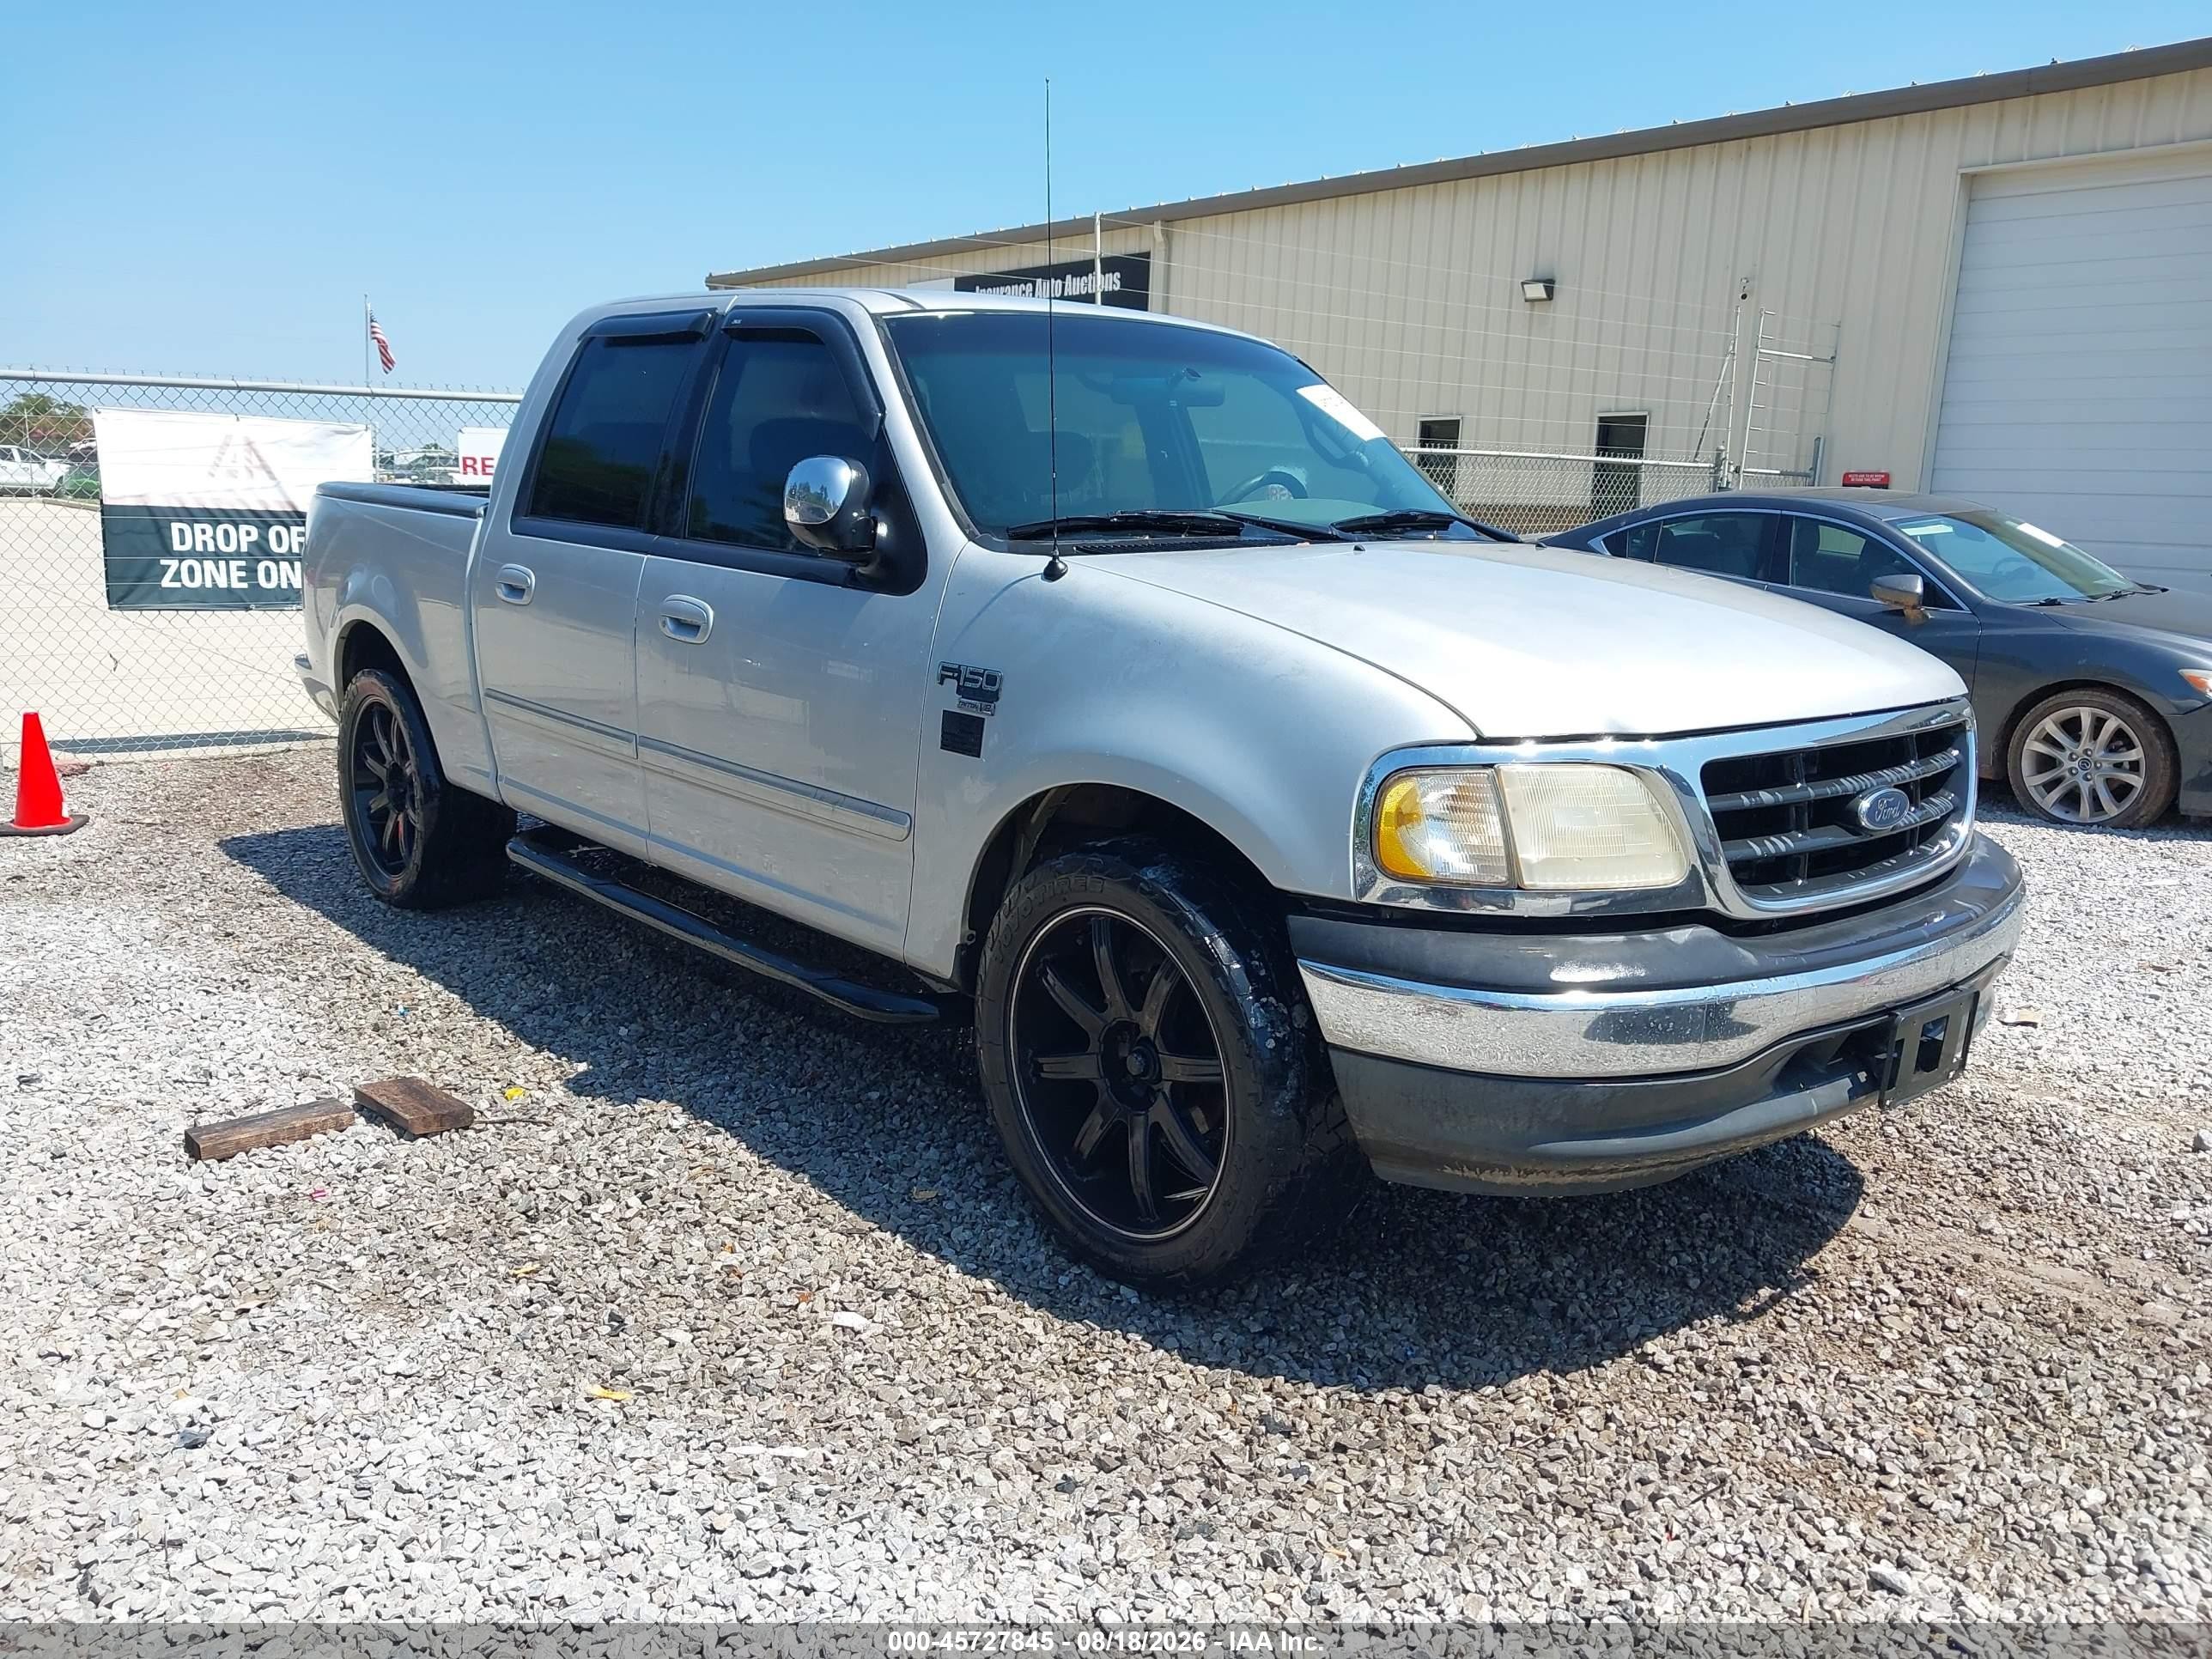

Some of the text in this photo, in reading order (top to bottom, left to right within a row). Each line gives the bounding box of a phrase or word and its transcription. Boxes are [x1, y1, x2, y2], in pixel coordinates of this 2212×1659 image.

[1035, 278, 1062, 299] Auto
[462, 456, 495, 476] RE
[170, 522, 258, 553] DROP
[160, 559, 249, 588] ZONE
[1875, 798, 1901, 822] Ford
